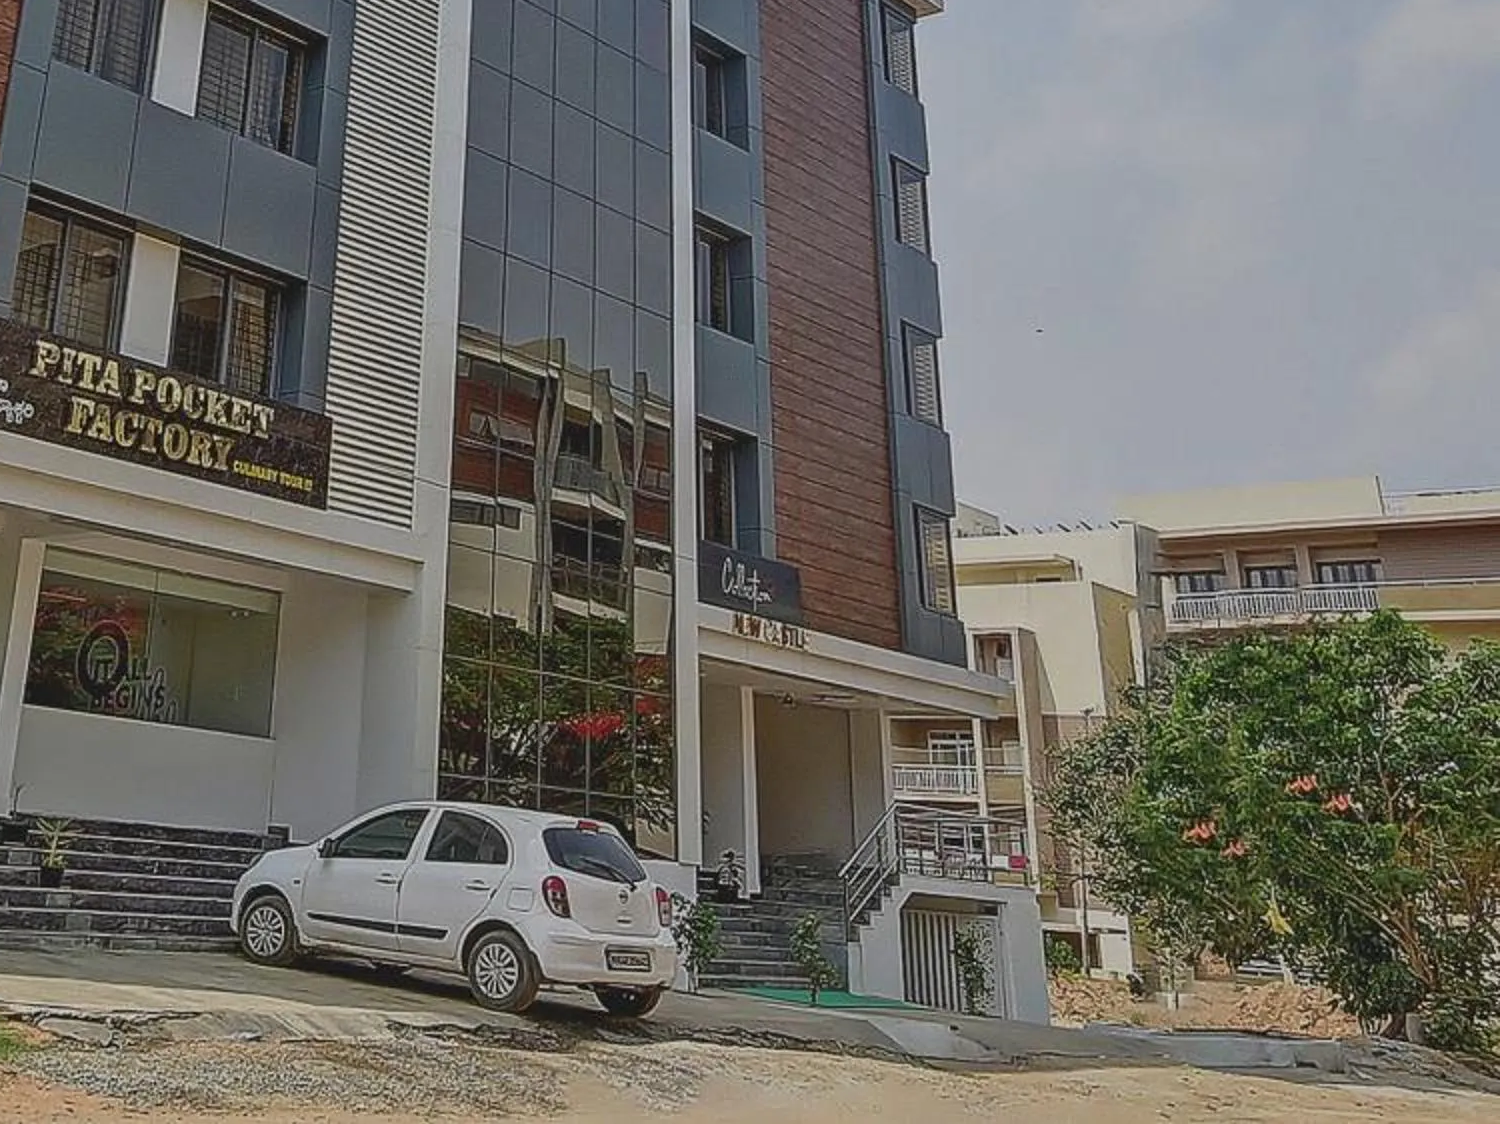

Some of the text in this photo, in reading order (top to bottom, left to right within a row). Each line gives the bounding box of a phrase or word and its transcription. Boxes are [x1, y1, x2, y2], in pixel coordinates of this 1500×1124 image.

[28, 339, 275, 439] PITA POCKET
[66, 395, 236, 471] FACTORY
